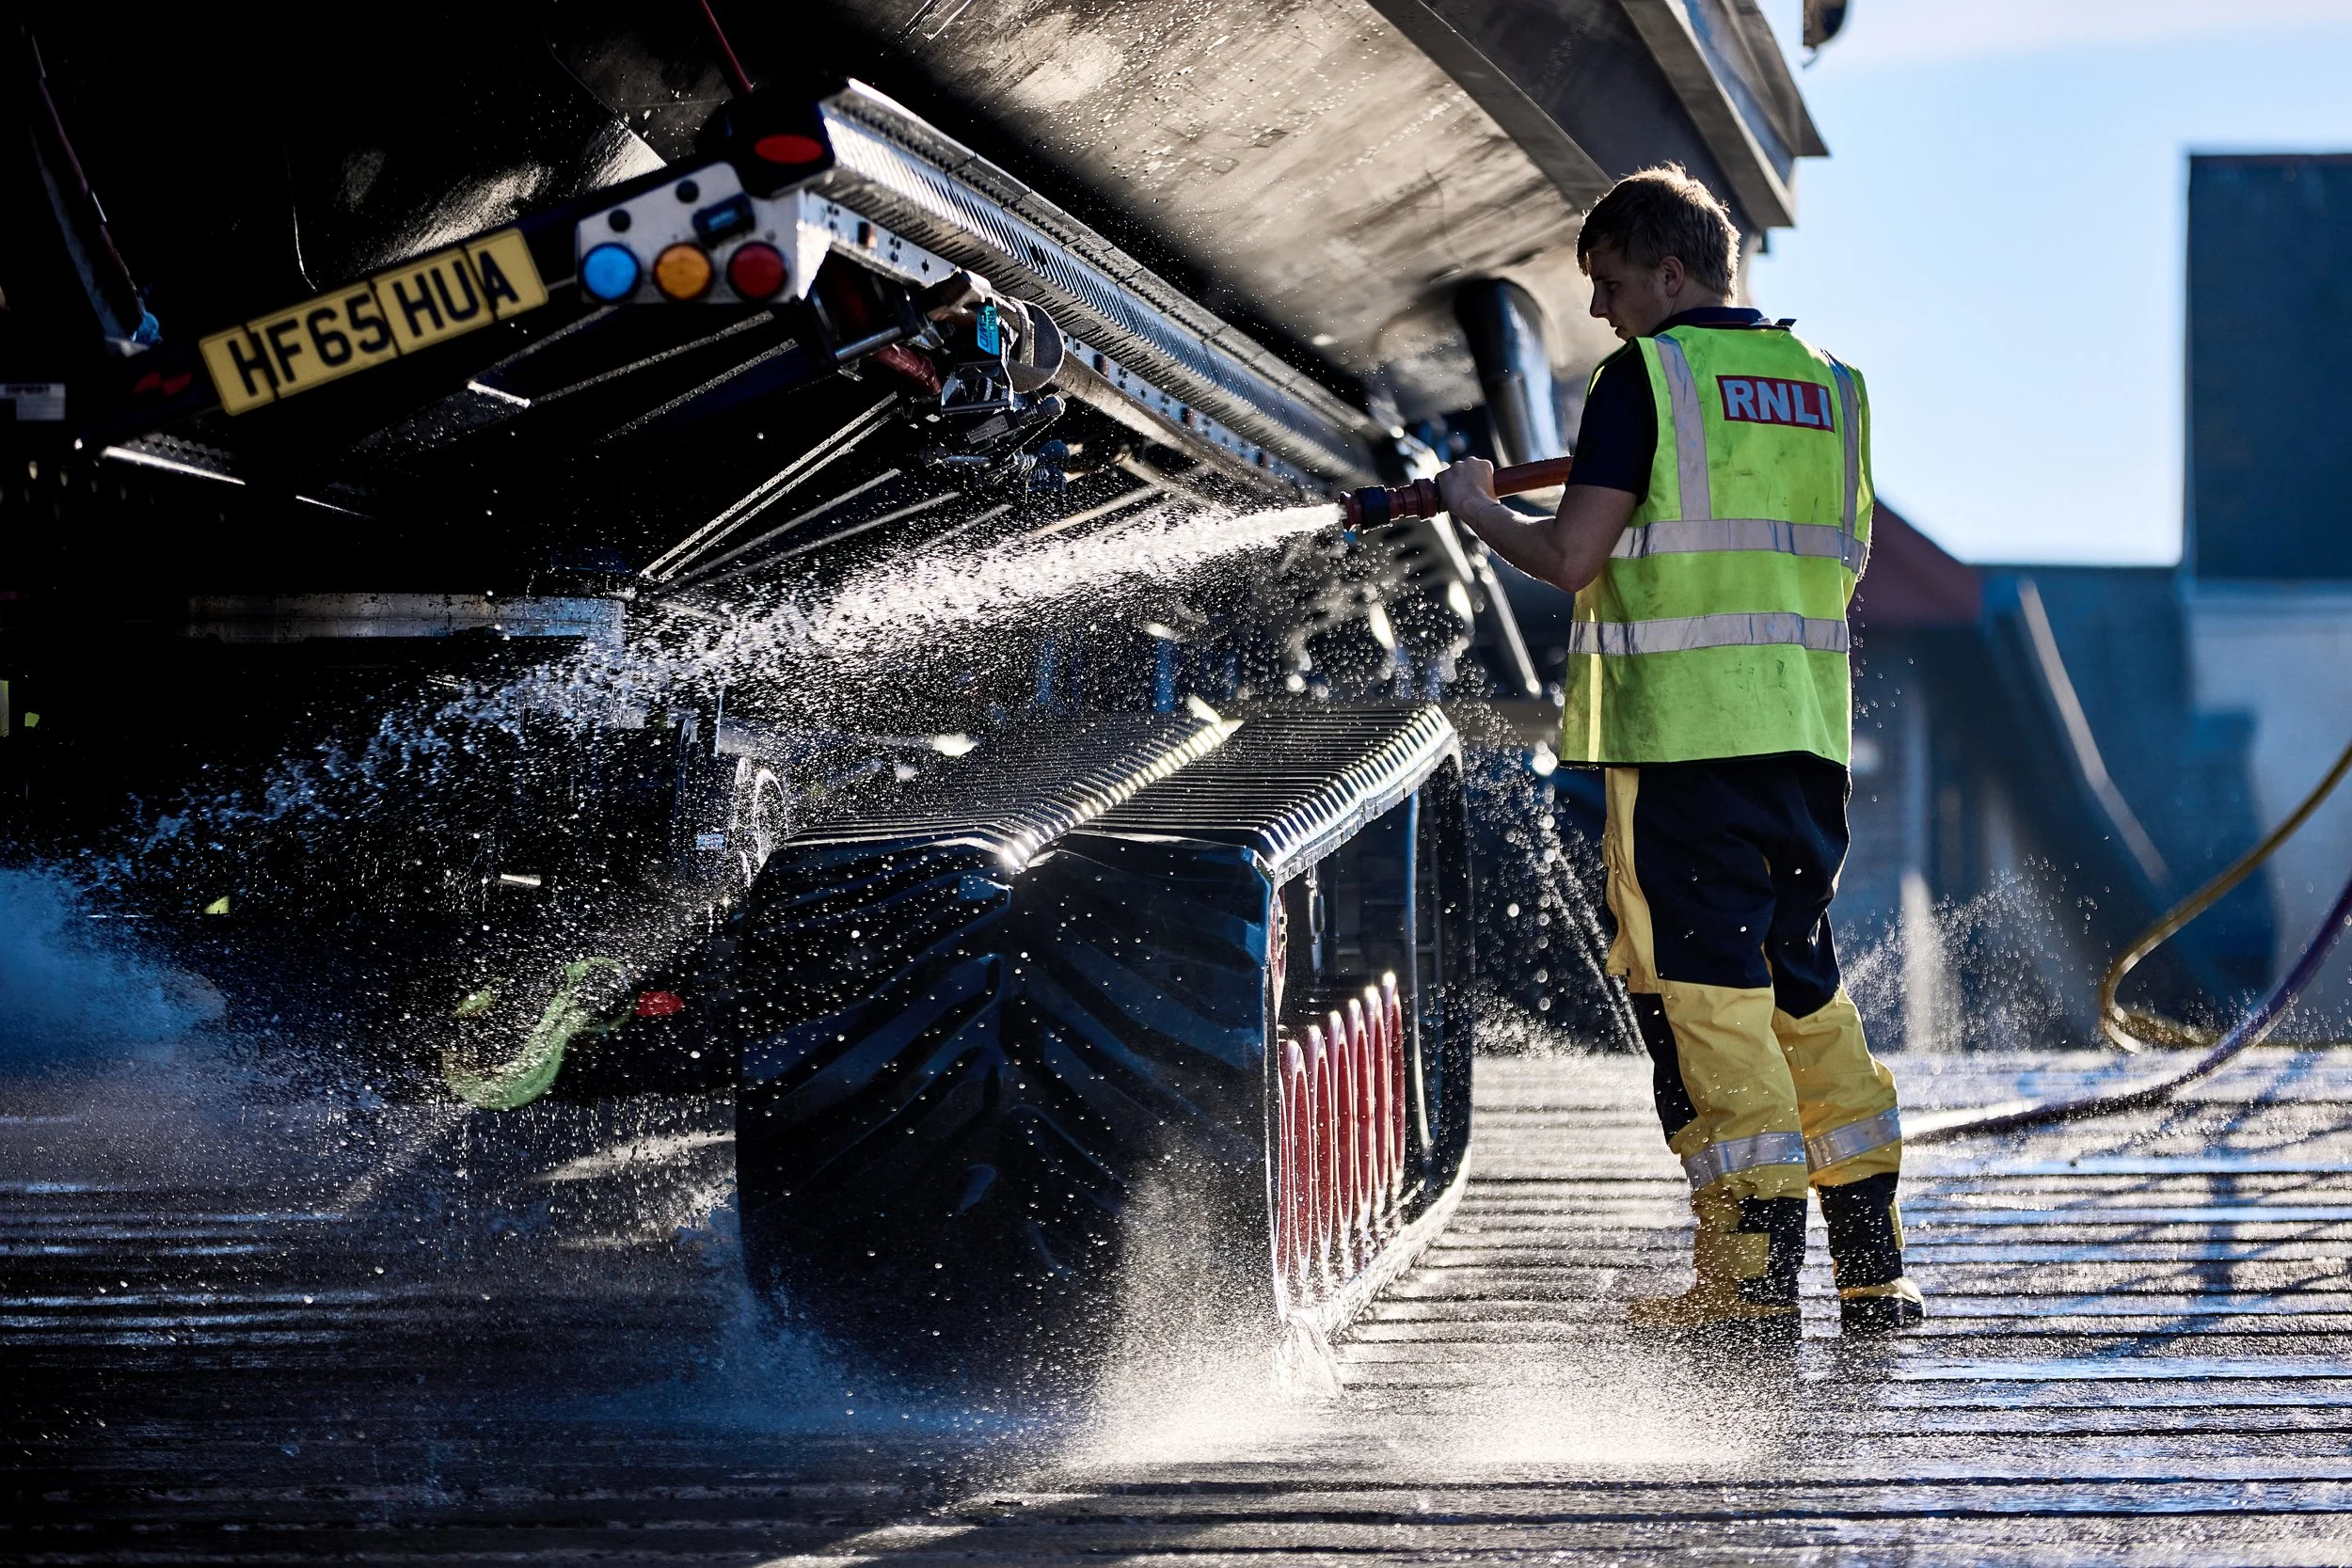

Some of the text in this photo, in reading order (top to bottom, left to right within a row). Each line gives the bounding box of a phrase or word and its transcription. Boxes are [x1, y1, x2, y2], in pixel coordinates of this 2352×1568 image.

[227, 250, 519, 397] HF65 HUA
[1722, 379, 1832, 428] RNLI
